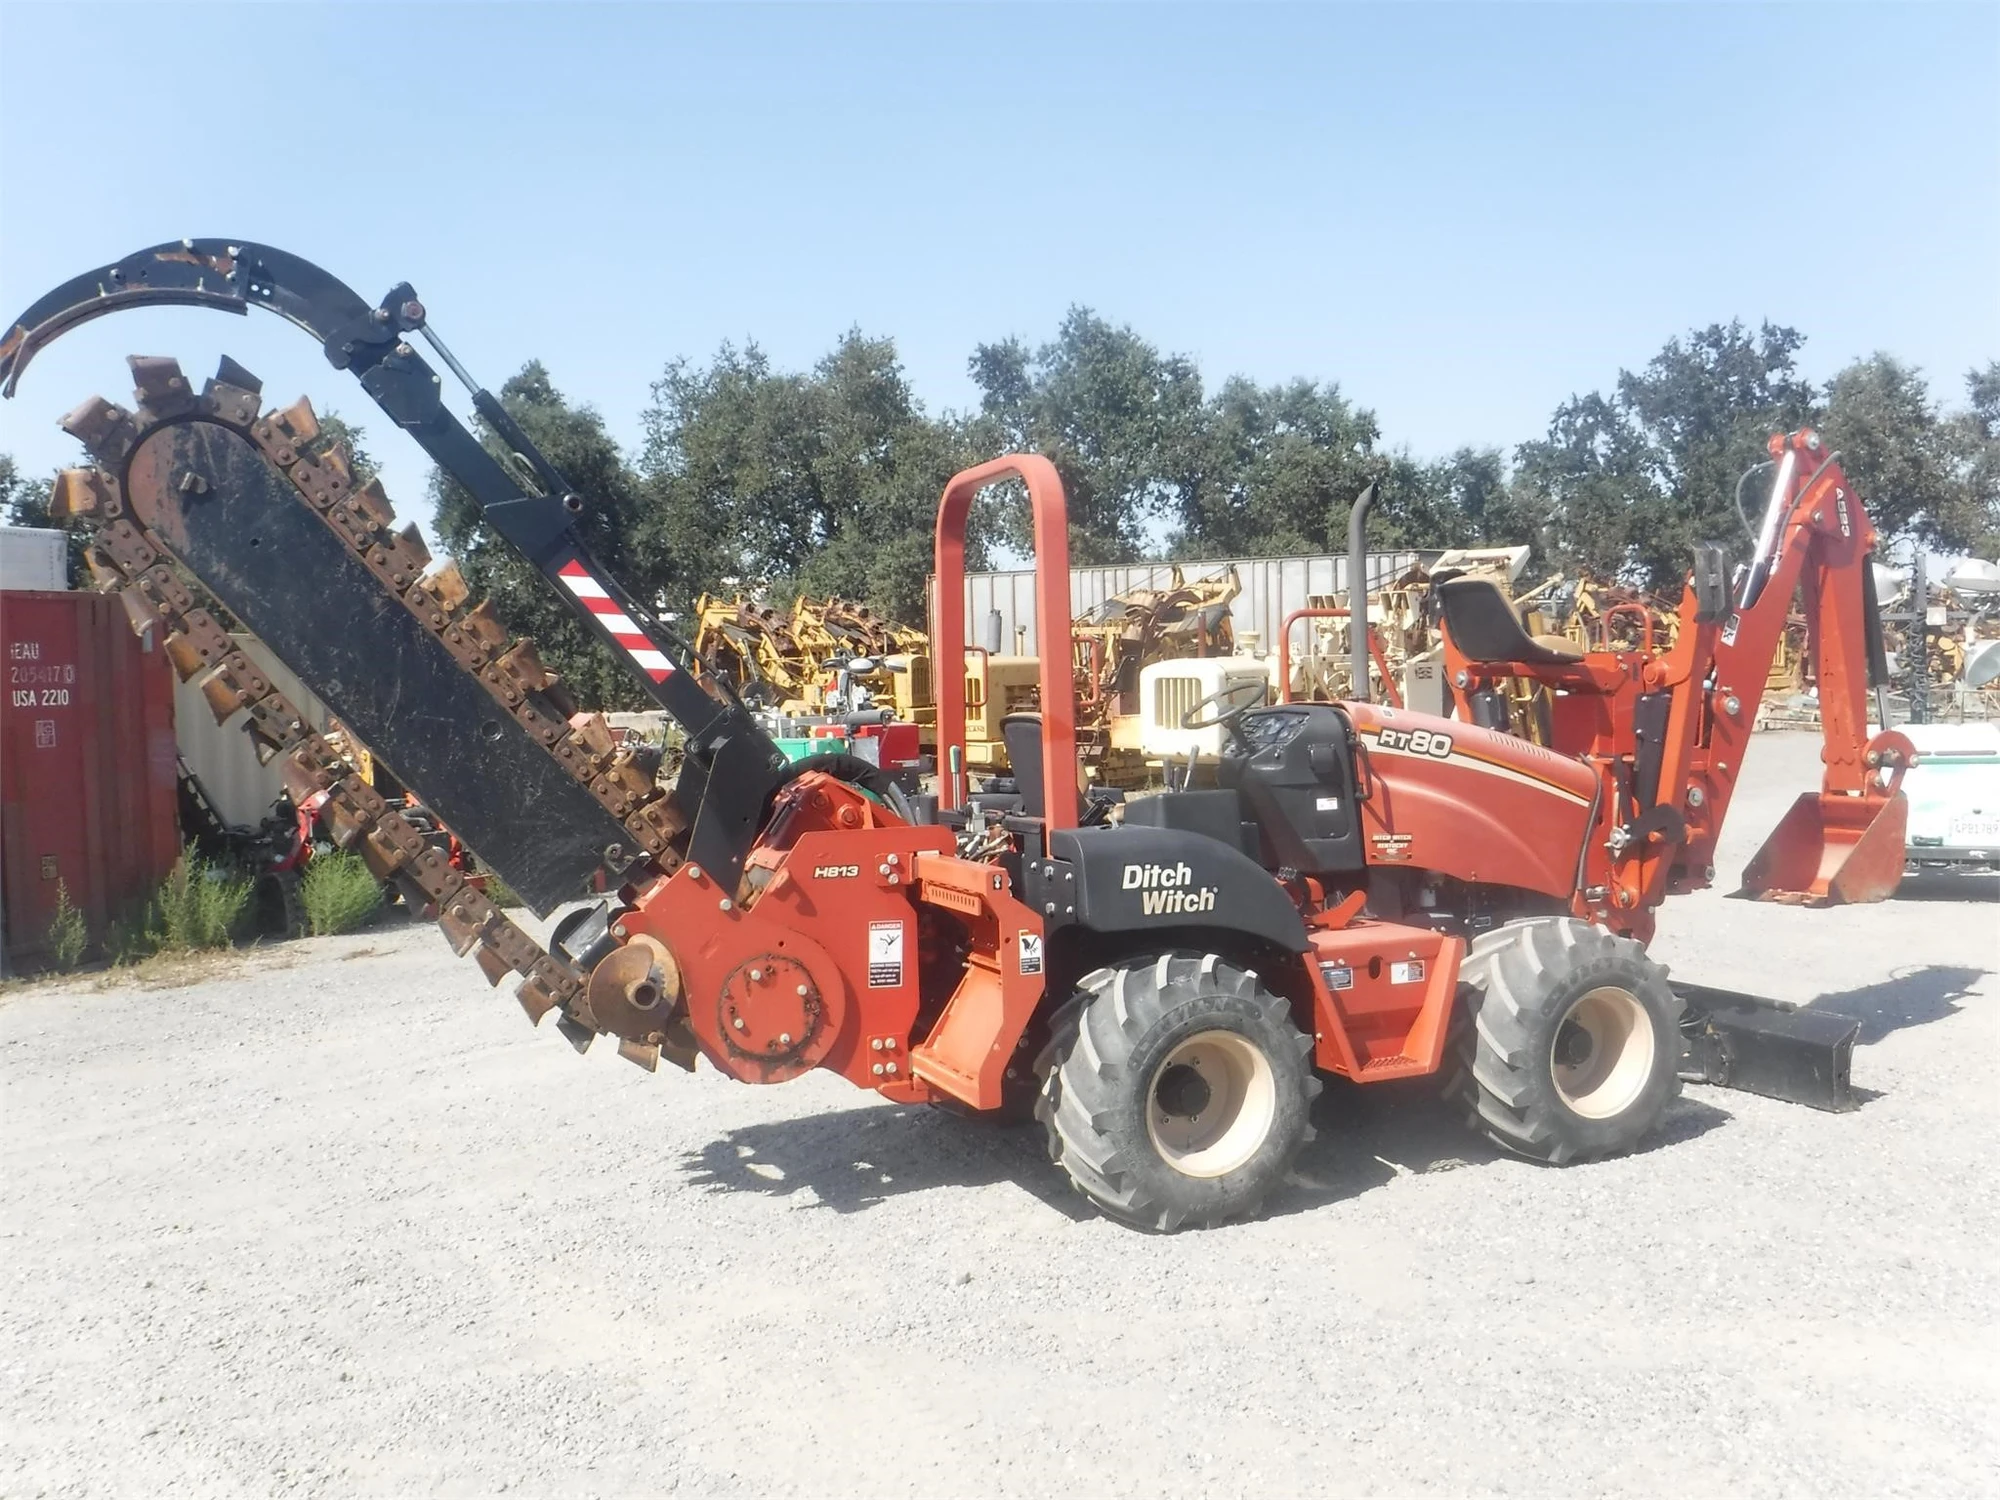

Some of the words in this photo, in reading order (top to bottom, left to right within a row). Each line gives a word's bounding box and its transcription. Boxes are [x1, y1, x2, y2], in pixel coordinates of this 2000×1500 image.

[13, 690, 37, 707] USA
[42, 689, 69, 706] 2210
[1378, 729, 1453, 758] RT80
[1122, 862, 1192, 889] Ditch
[1142, 887, 1215, 915] Witch
